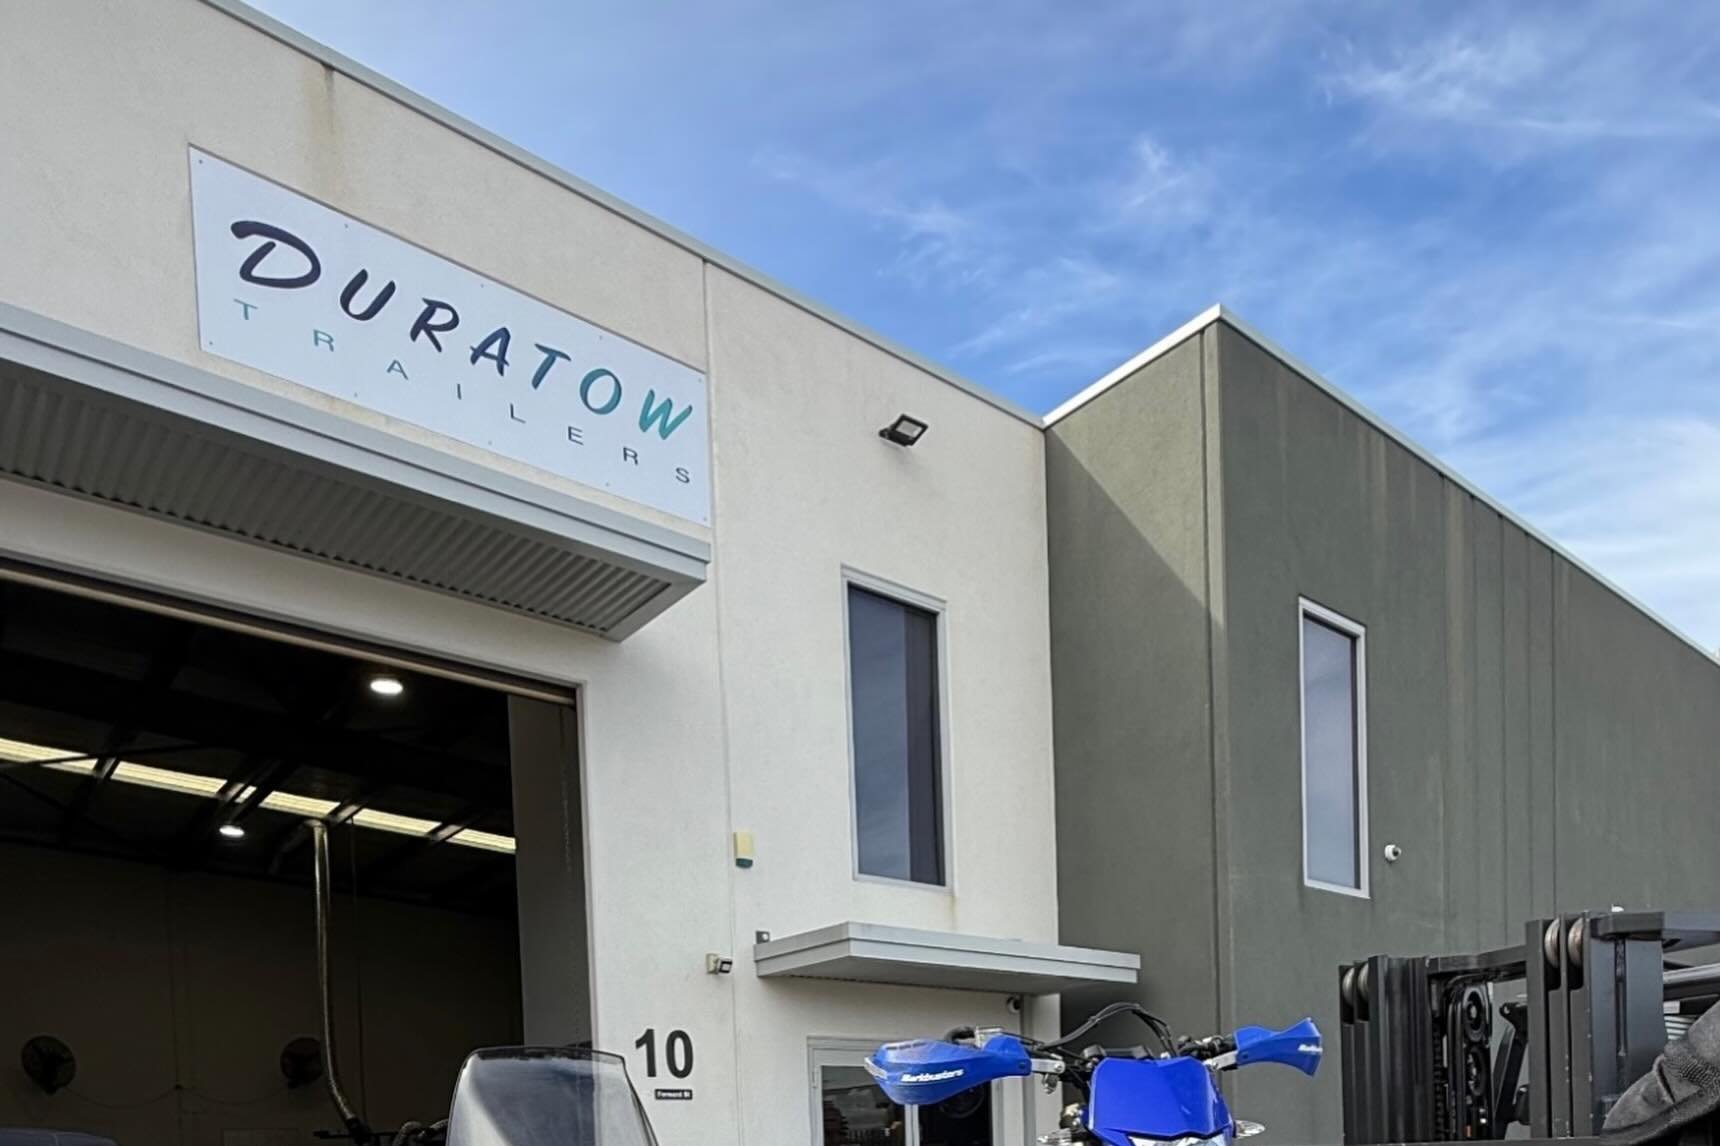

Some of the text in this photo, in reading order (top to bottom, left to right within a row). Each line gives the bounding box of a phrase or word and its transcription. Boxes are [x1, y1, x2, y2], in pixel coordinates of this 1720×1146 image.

[230, 220, 693, 440] DURATOW
[234, 298, 690, 484] TRAILERS
[635, 1028, 694, 1079] 10
